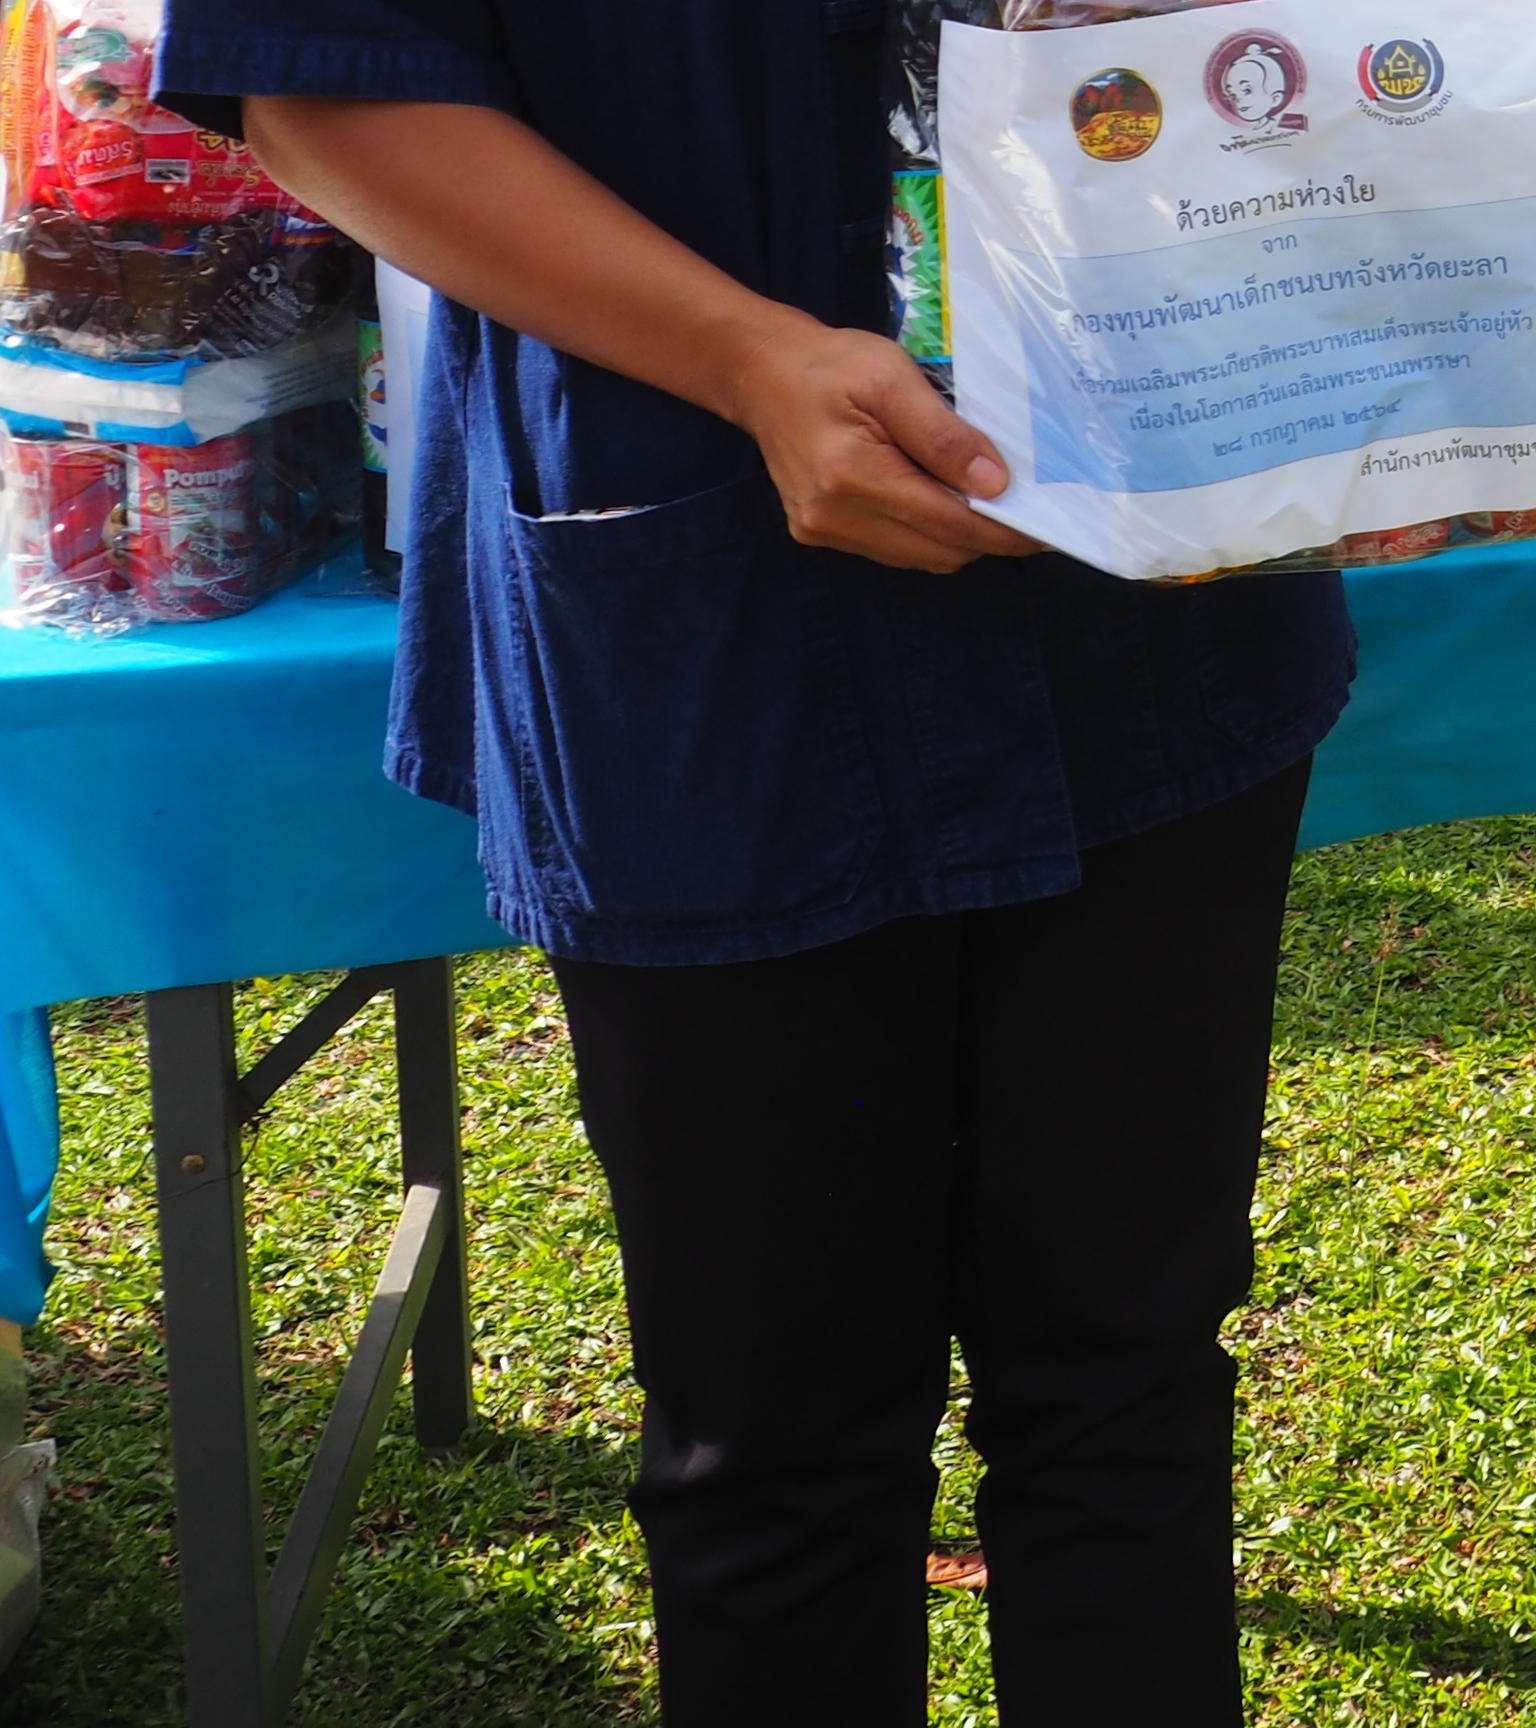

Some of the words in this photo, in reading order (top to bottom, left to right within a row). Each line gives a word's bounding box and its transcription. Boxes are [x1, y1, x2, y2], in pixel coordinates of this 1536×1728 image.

[1355, 89, 1453, 127] กรมการพัฒนาชุมชน
[1176, 175, 1377, 233] ด้วยความห่วงใย
[1262, 231, 1298, 254] จาก
[1073, 250, 1509, 337] กองทุนพัฒนาเด็กชนบทจังหวัดยะลา
[1129, 350, 1472, 432] เนื่องในโอกาสวันเฉลิมพระชนมพรรษา
[1212, 435, 1244, 459] ๒๘
[1248, 414, 1336, 457] กรกฎาคม
[1341, 398, 1402, 441] ๒๕๖๔
